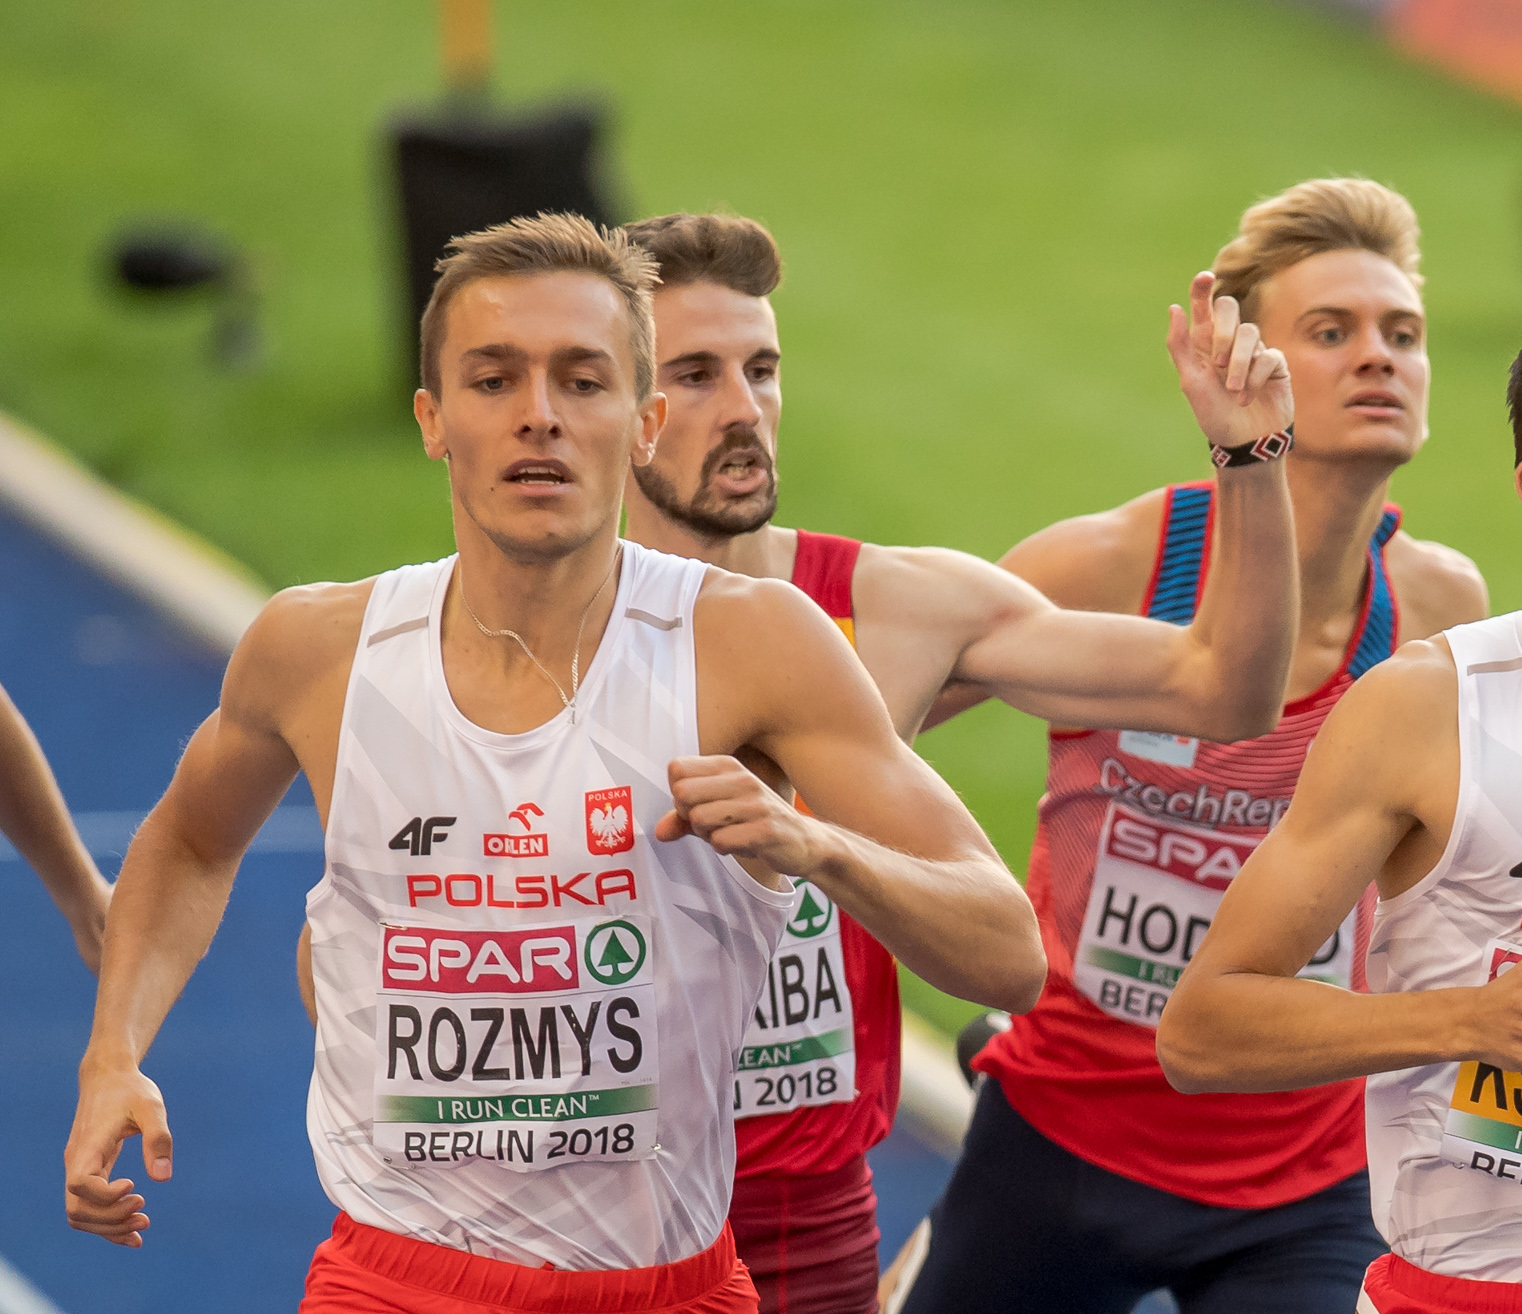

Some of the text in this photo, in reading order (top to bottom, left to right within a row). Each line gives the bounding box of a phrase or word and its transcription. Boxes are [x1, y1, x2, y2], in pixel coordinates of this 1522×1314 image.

[588, 790, 628, 802] POLSKA
[388, 816, 457, 857] 4F
[1113, 819, 1244, 881] SPA
[406, 868, 637, 909] POLSKA
[387, 935, 573, 984] SPAR
[386, 997, 643, 1082] ROZMYS
[755, 1066, 837, 1107] 2018
[437, 1101, 443, 1120] I
[452, 1099, 504, 1120] RUN
[404, 1123, 635, 1164] BERLIN 2018
[1514, 1131, 1522, 1149] I
